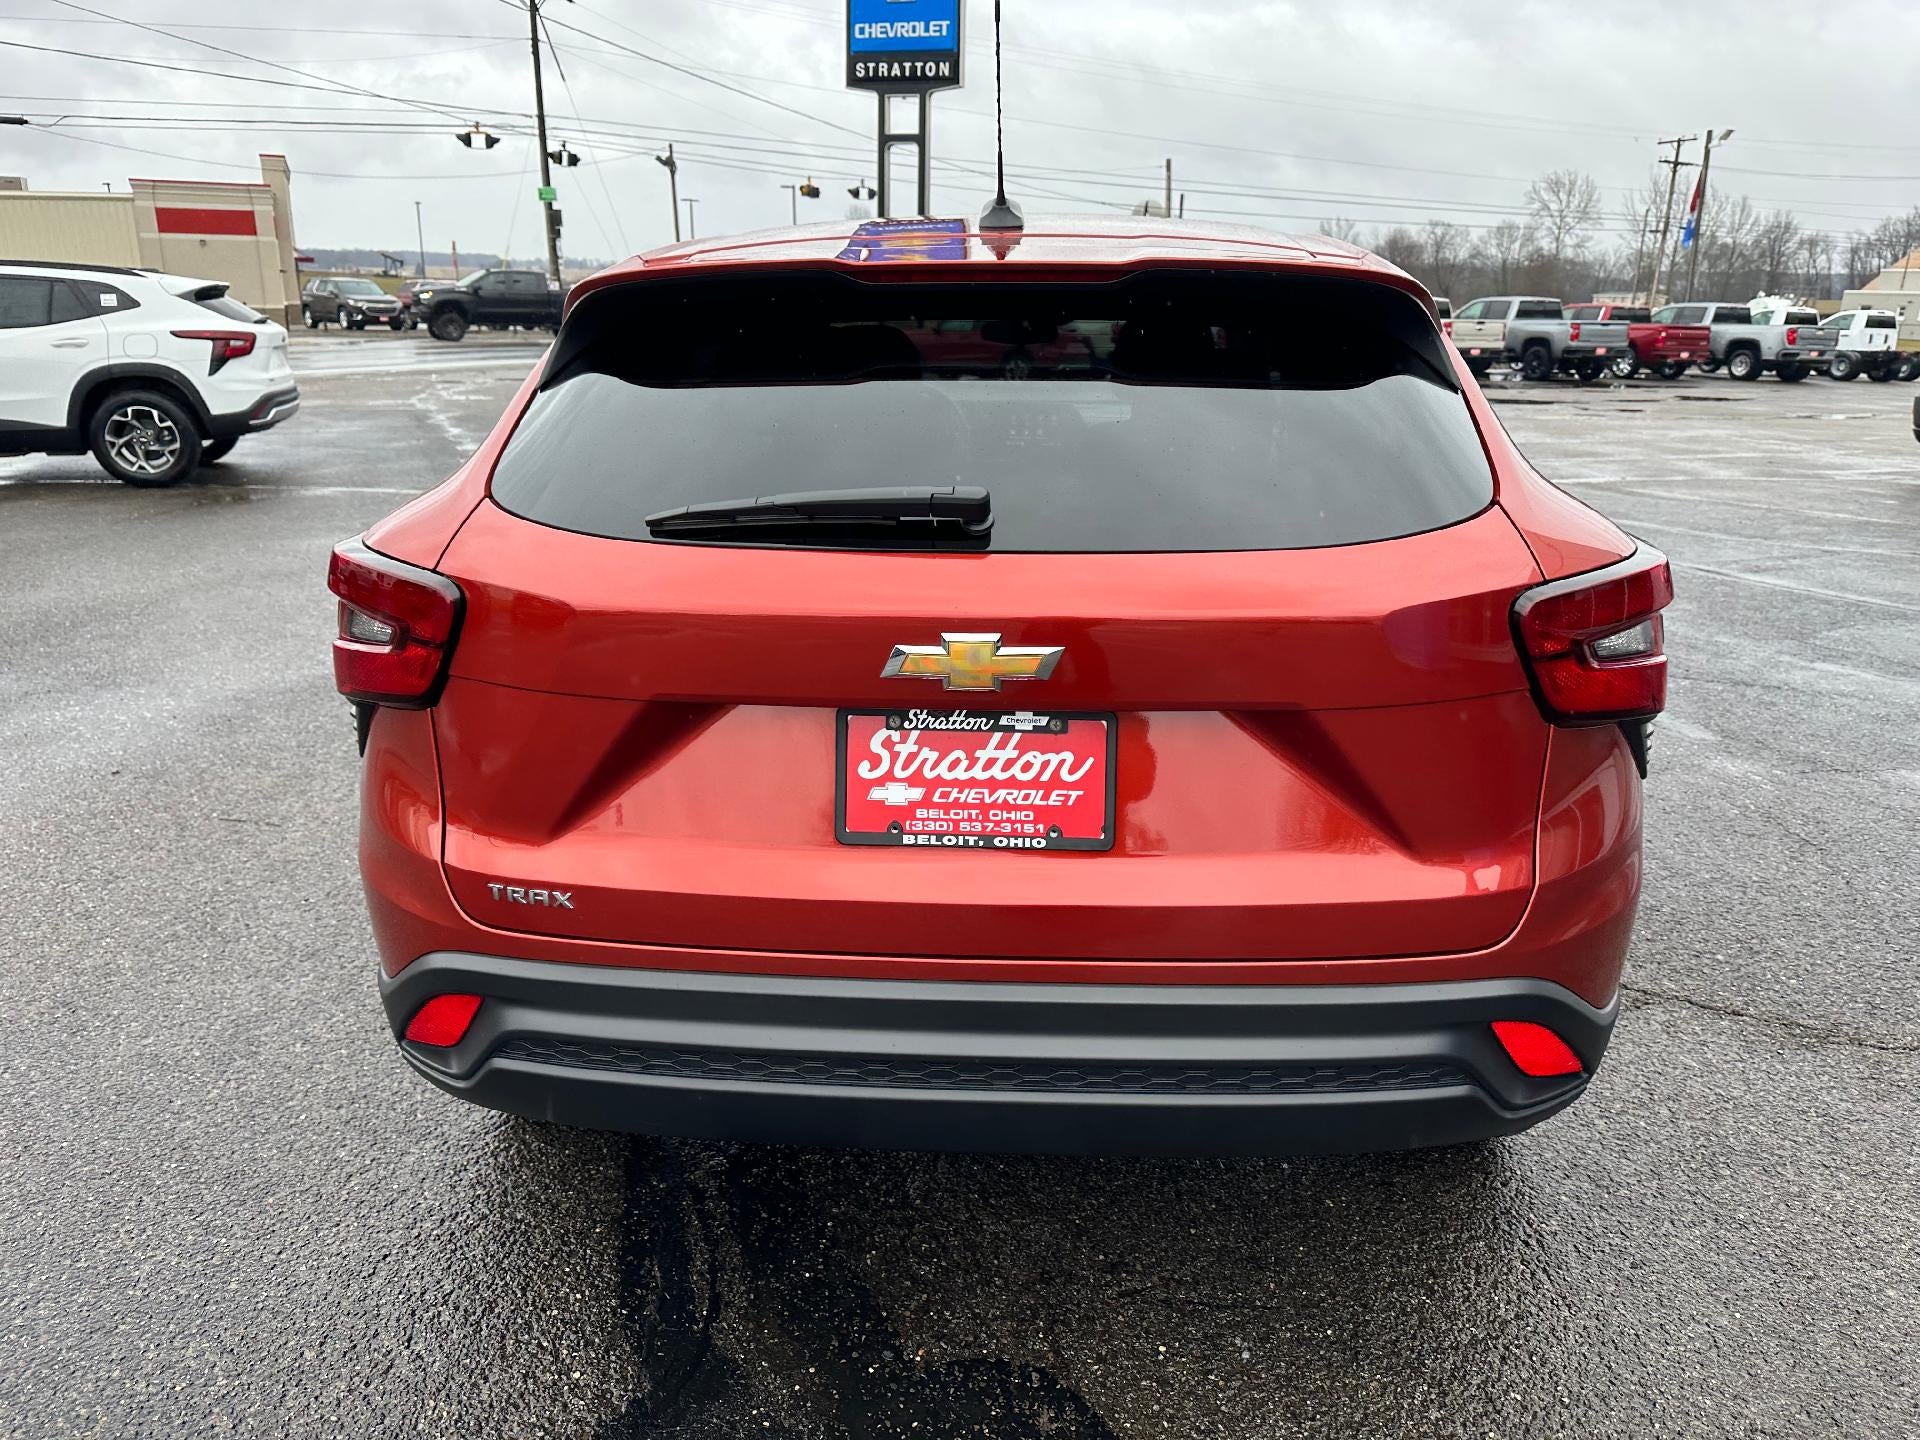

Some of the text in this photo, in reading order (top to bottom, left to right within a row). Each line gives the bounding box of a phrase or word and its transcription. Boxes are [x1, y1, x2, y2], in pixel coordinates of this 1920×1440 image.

[854, 20, 951, 38] CHEVROLET
[855, 62, 950, 77] STRATTON
[903, 709, 1042, 731] Stratton Chevrolet
[857, 727, 1095, 782] Stratton
[932, 787, 1084, 806] CHEVROLET
[915, 808, 1034, 822] BELOIT, OHIO
[905, 820, 1045, 834] (330) 537-3151
[902, 834, 1048, 849] BELOIT, OHIO
[487, 883, 574, 909] TRAX
